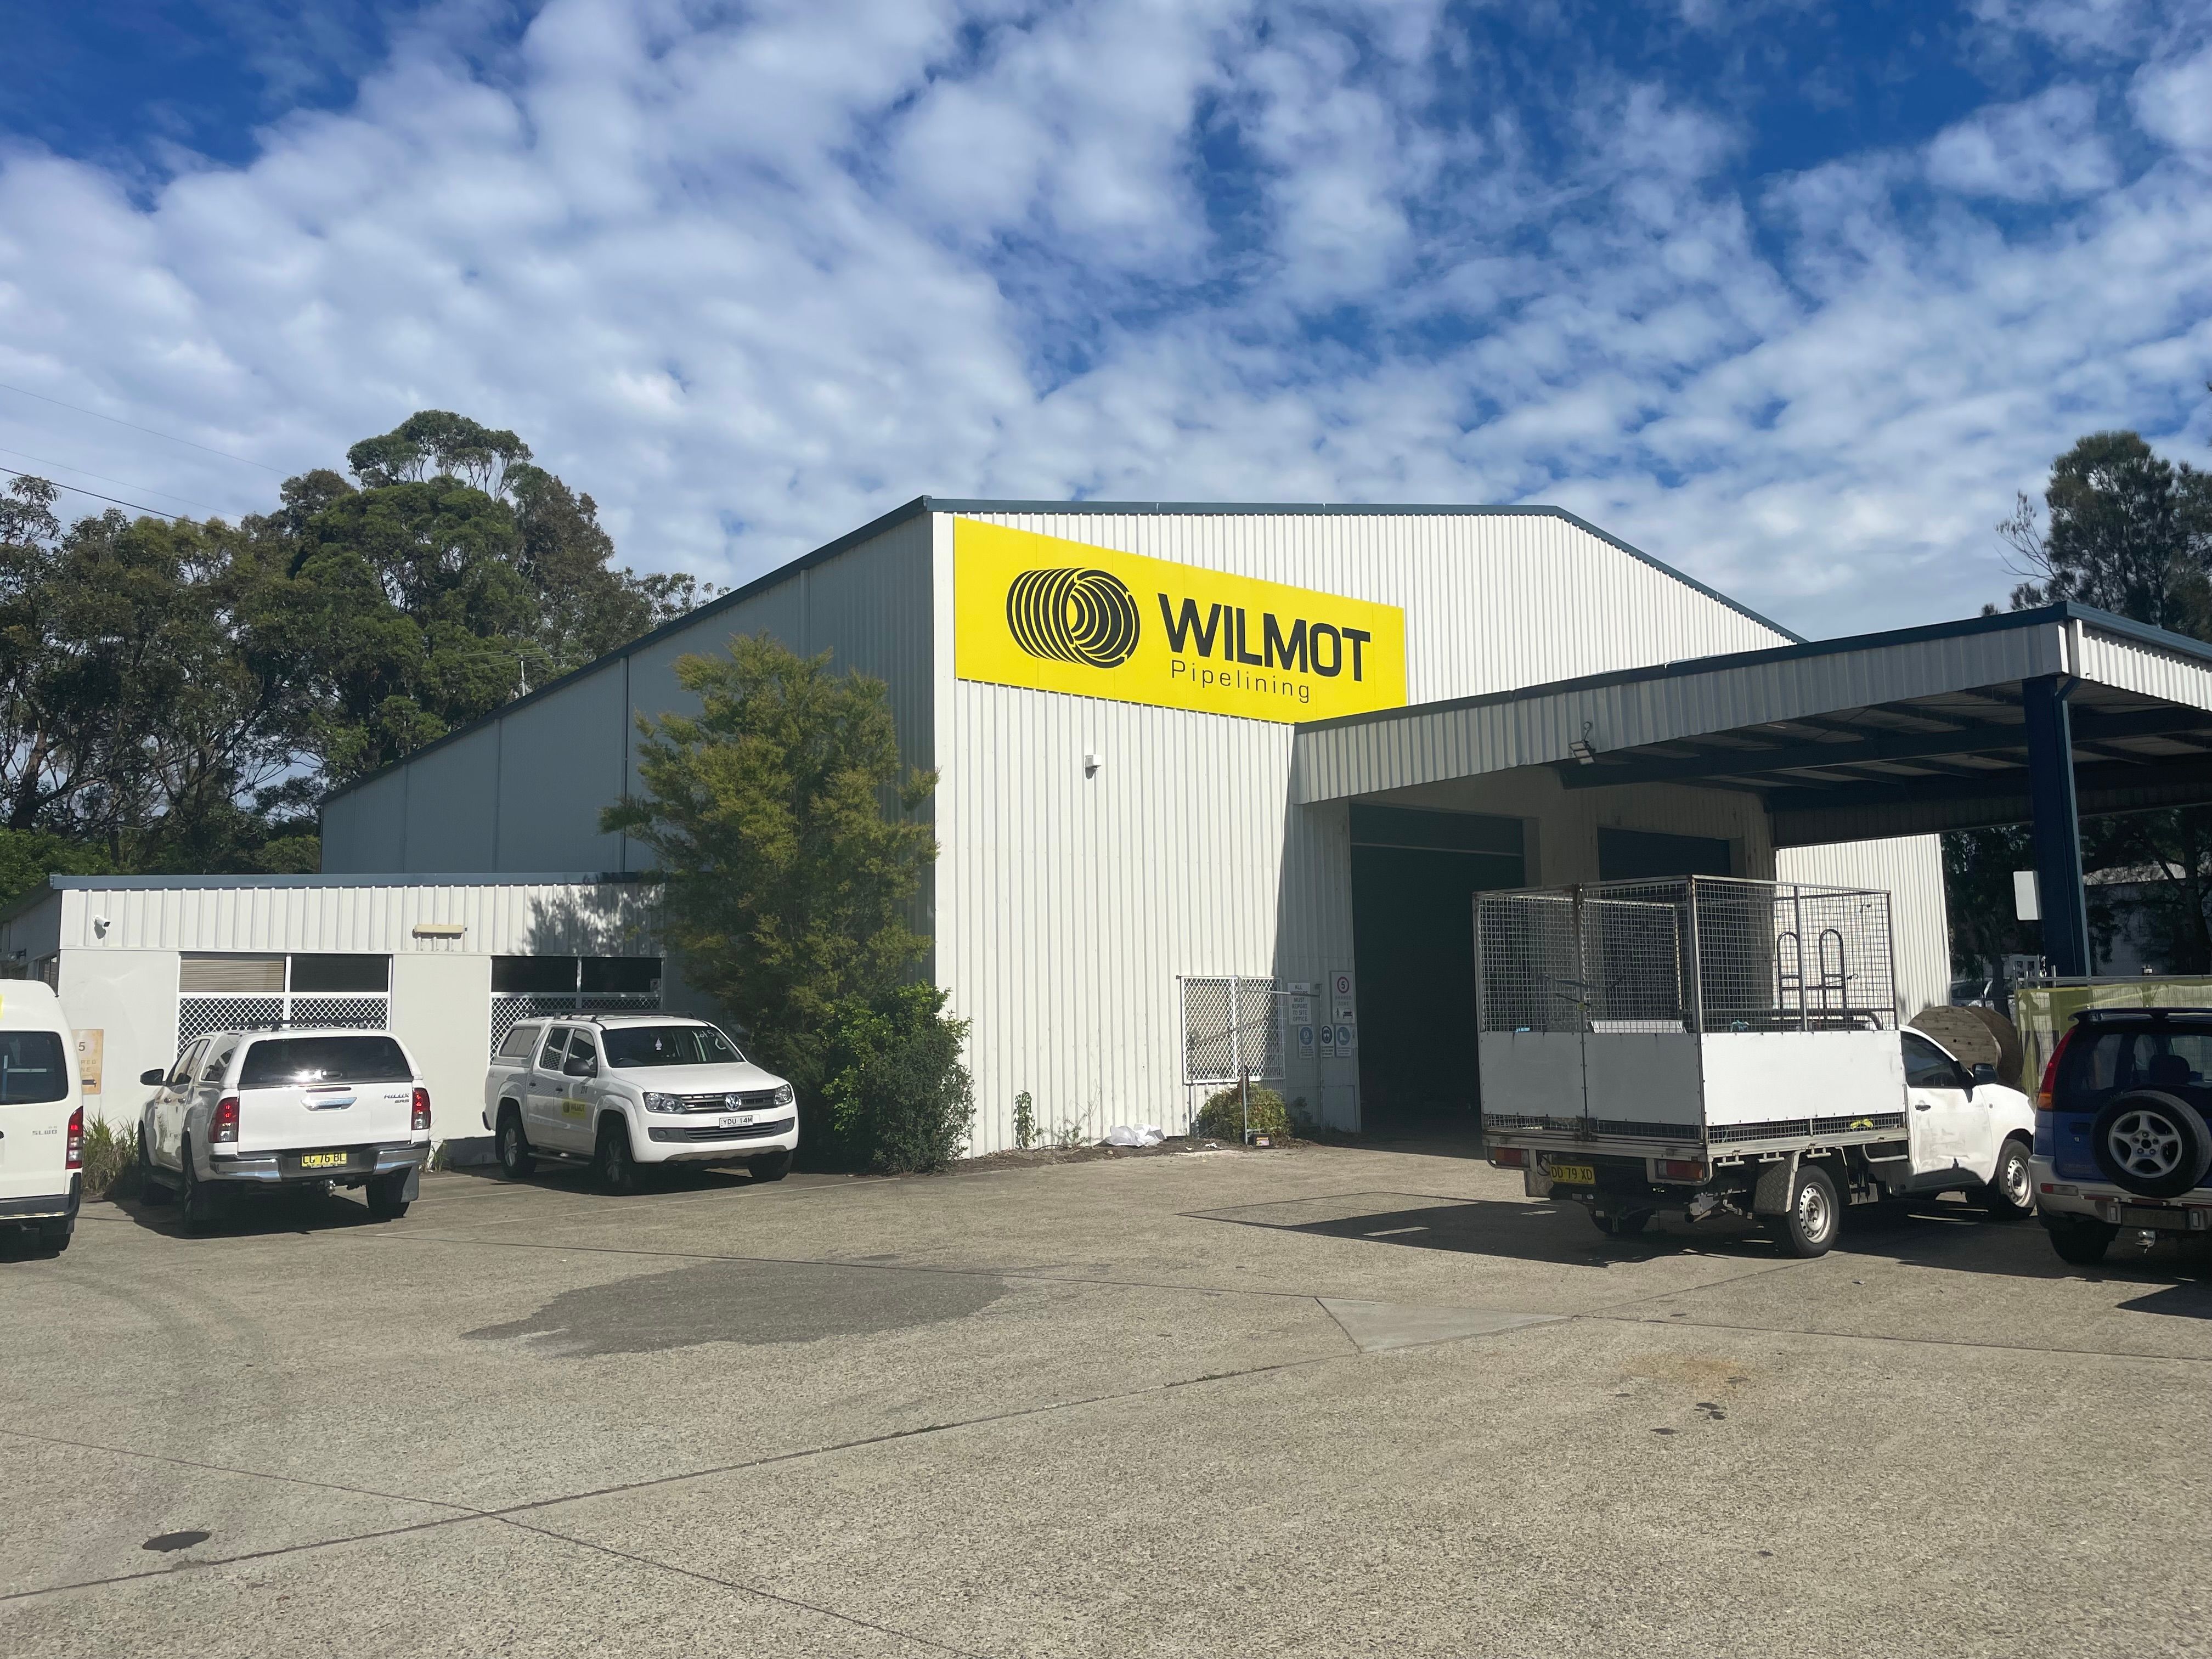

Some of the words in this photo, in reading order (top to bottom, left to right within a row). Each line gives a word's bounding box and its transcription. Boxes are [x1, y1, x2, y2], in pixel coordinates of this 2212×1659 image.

[1158, 592, 1371, 682] WILMOT
[1171, 659, 1310, 703] Pipelining
[1341, 981, 1345, 989] 5
[78, 1041, 86, 1051] 5
[334, 1153, 346, 1162] BL
[1551, 1166, 1564, 1178] DD
[1565, 1167, 1577, 1179] 79
[1580, 1167, 1593, 1180] XD
